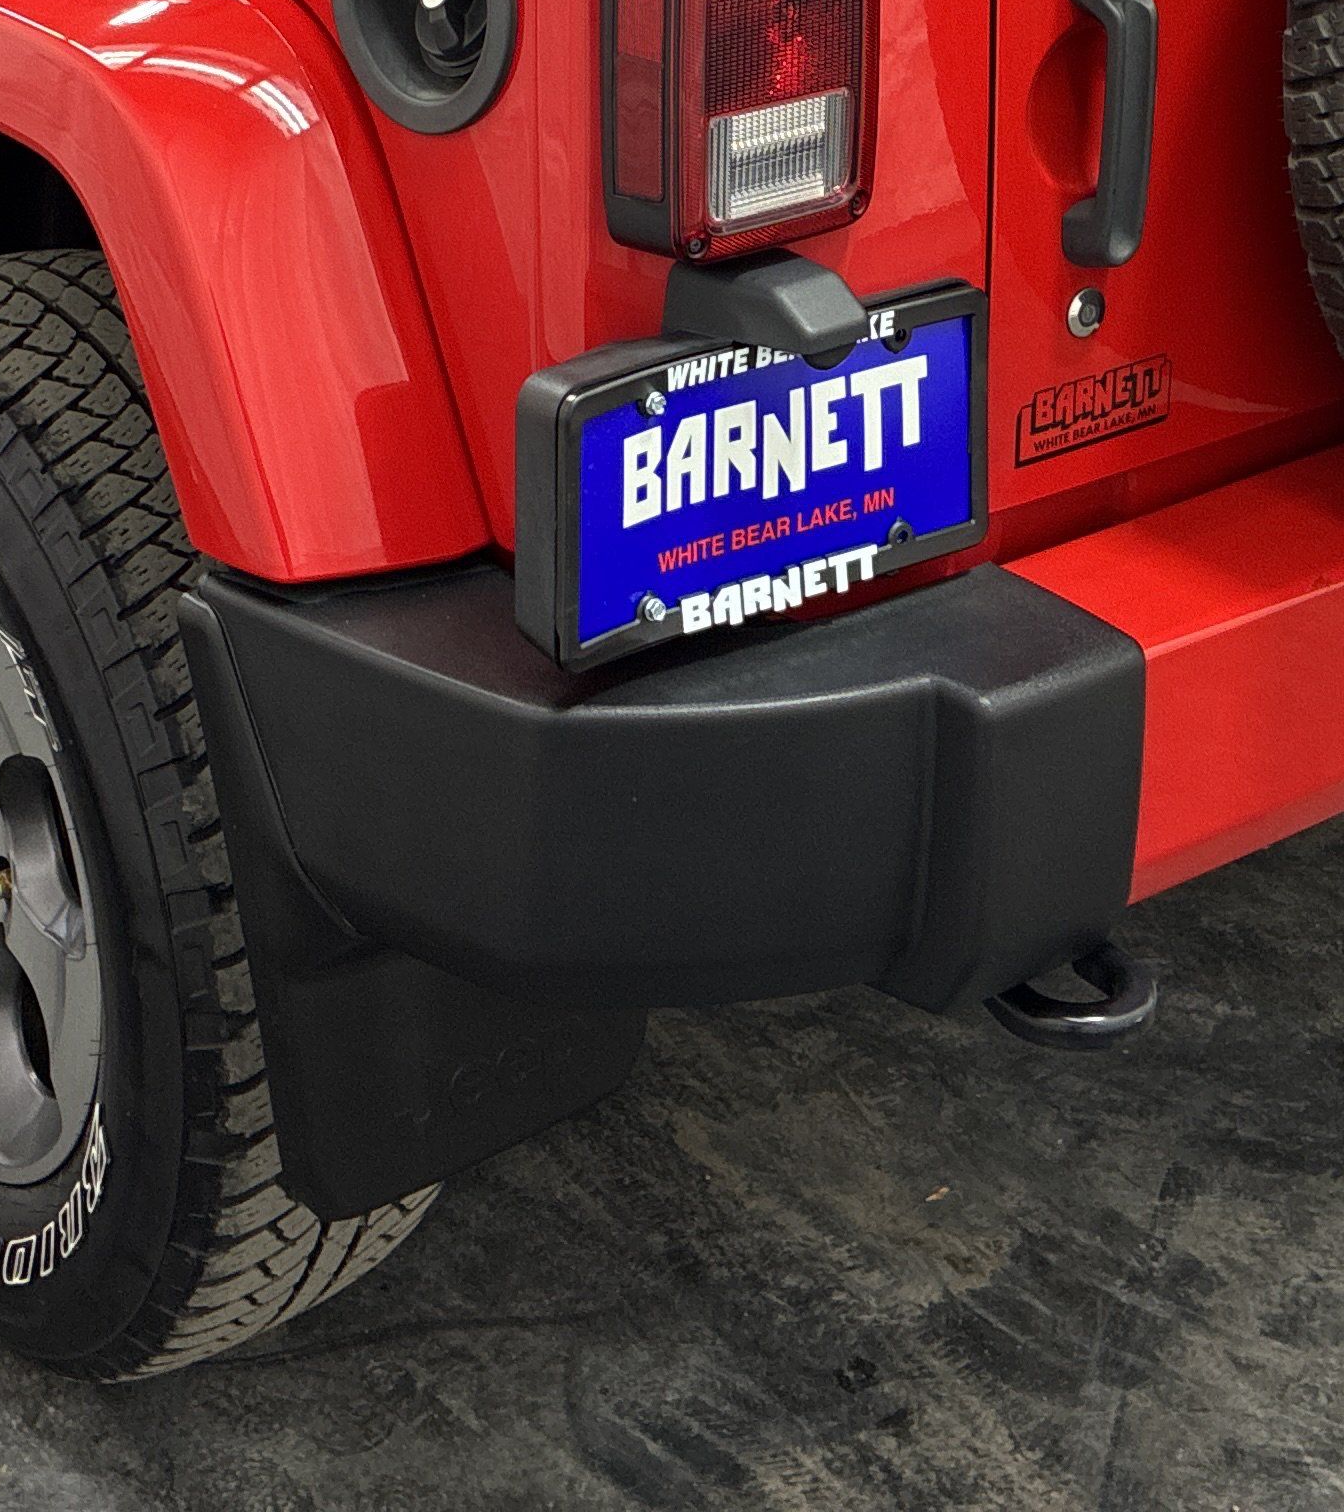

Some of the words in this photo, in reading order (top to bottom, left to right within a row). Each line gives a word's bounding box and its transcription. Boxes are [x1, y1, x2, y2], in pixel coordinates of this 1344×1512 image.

[667, 347, 750, 392] WHITE
[1031, 354, 1170, 434] BARNETT
[622, 355, 929, 529] BARNETT
[1033, 431, 1069, 453] WHITE
[1072, 422, 1100, 441] BEAR
[1103, 411, 1135, 431] LAKE,
[1138, 404, 1156, 419] MN
[658, 533, 725, 573] WHITE
[731, 516, 791, 551] BEAR
[796, 498, 857, 532] LAKE,
[863, 487, 895, 514] MN
[679, 544, 878, 634] BARNETT
